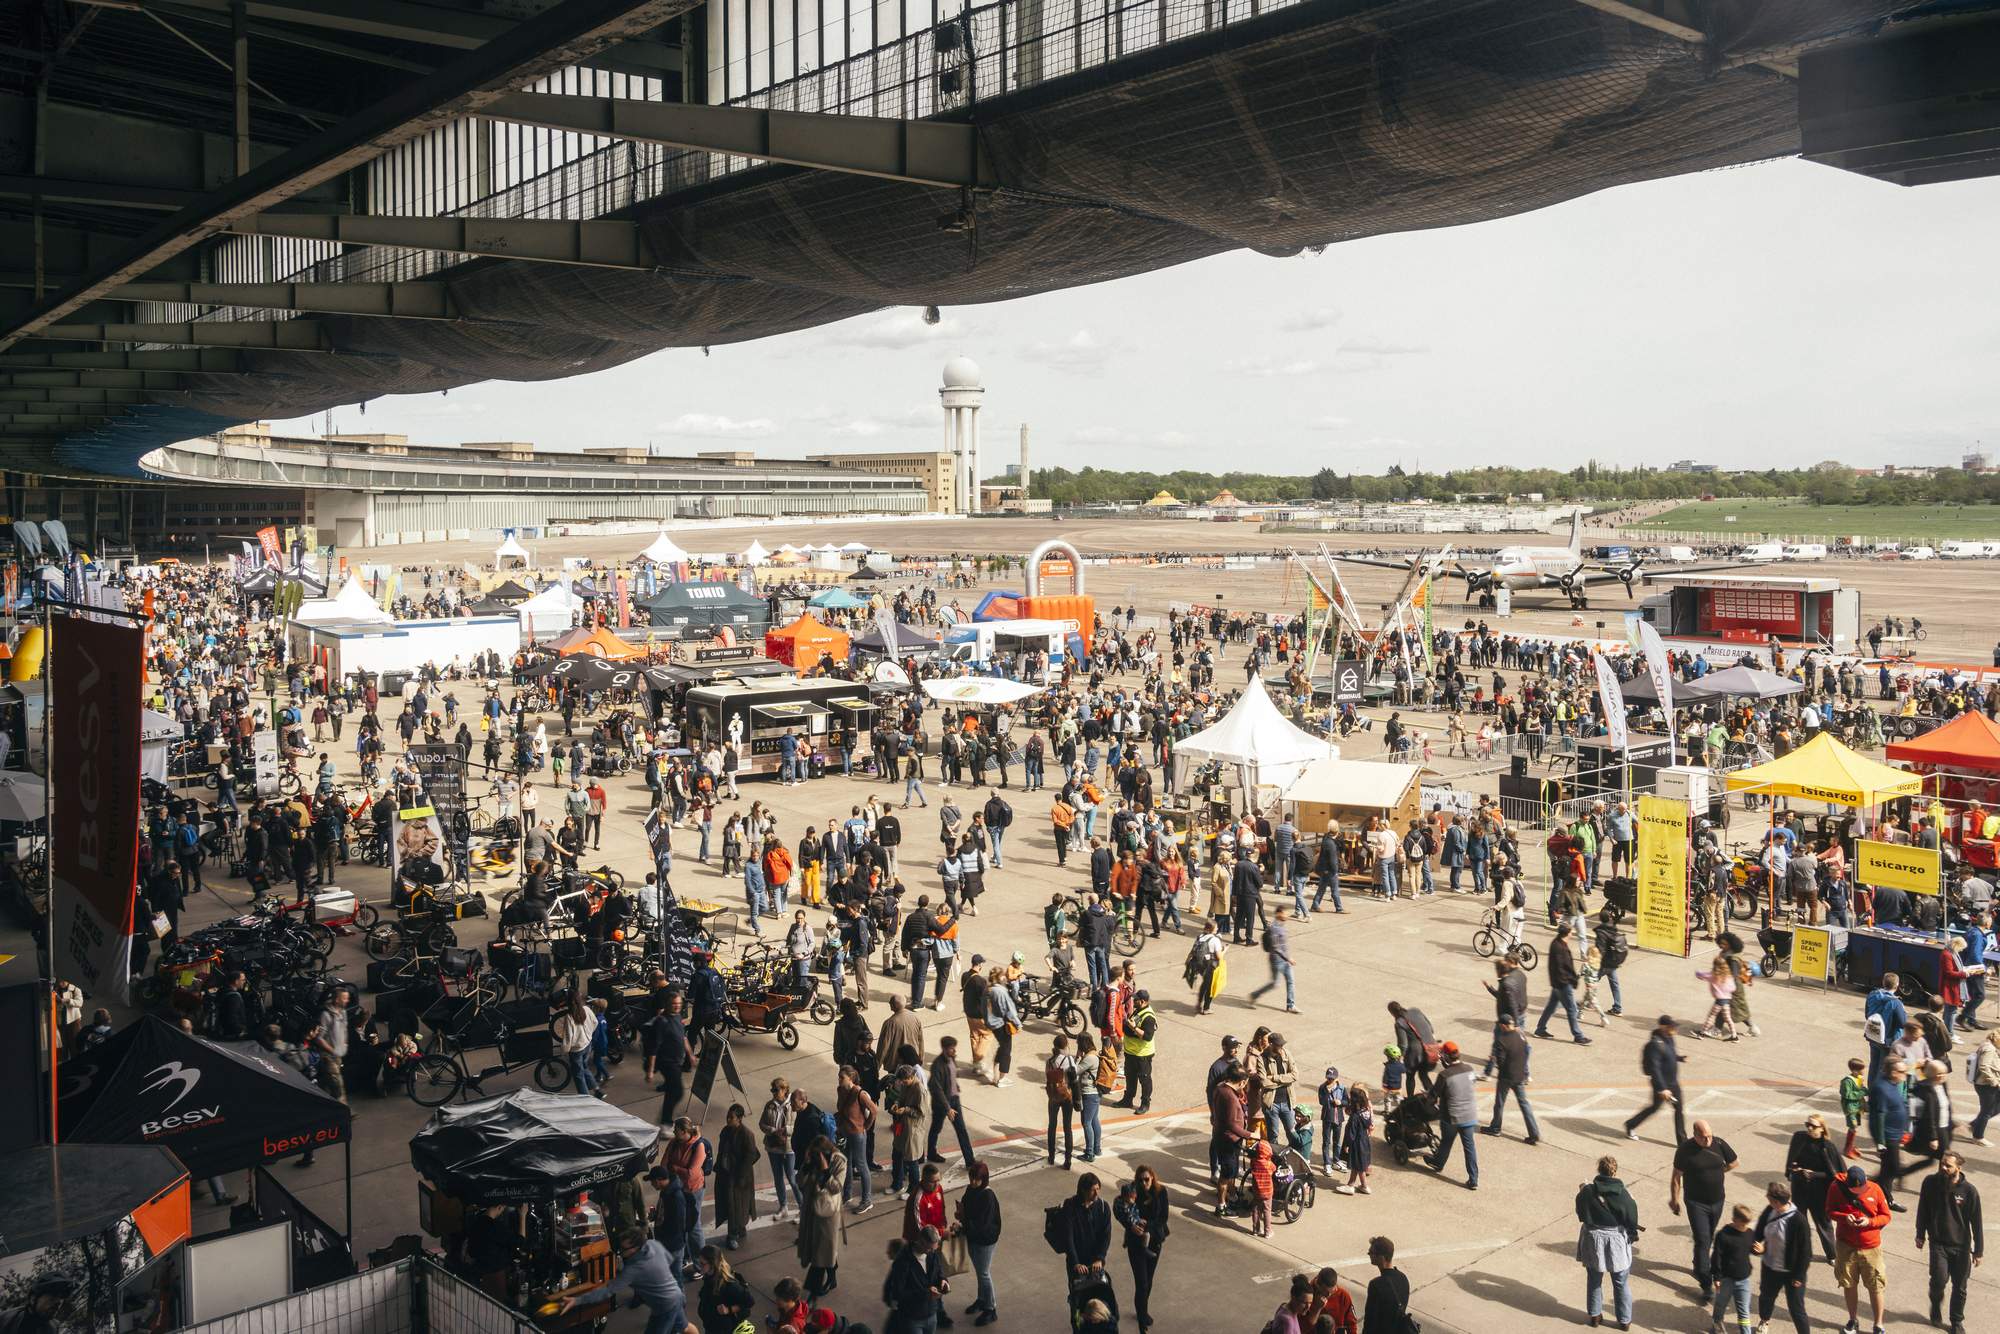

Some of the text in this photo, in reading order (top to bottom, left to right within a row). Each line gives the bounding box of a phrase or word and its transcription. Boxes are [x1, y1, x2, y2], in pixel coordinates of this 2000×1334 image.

[1337, 692, 1362, 700] WERKHAUS
[1896, 781, 1920, 792] isicargo
[1801, 785, 1857, 802] isicargo
[1642, 814, 1683, 828] isicargo
[1869, 857, 1926, 875] isicargo
[1801, 939, 1823, 948] SPRING
[1801, 944, 1817, 953] DEAL
[1806, 955, 1819, 963] 10%
[263, 1126, 340, 1157] besv.eu
